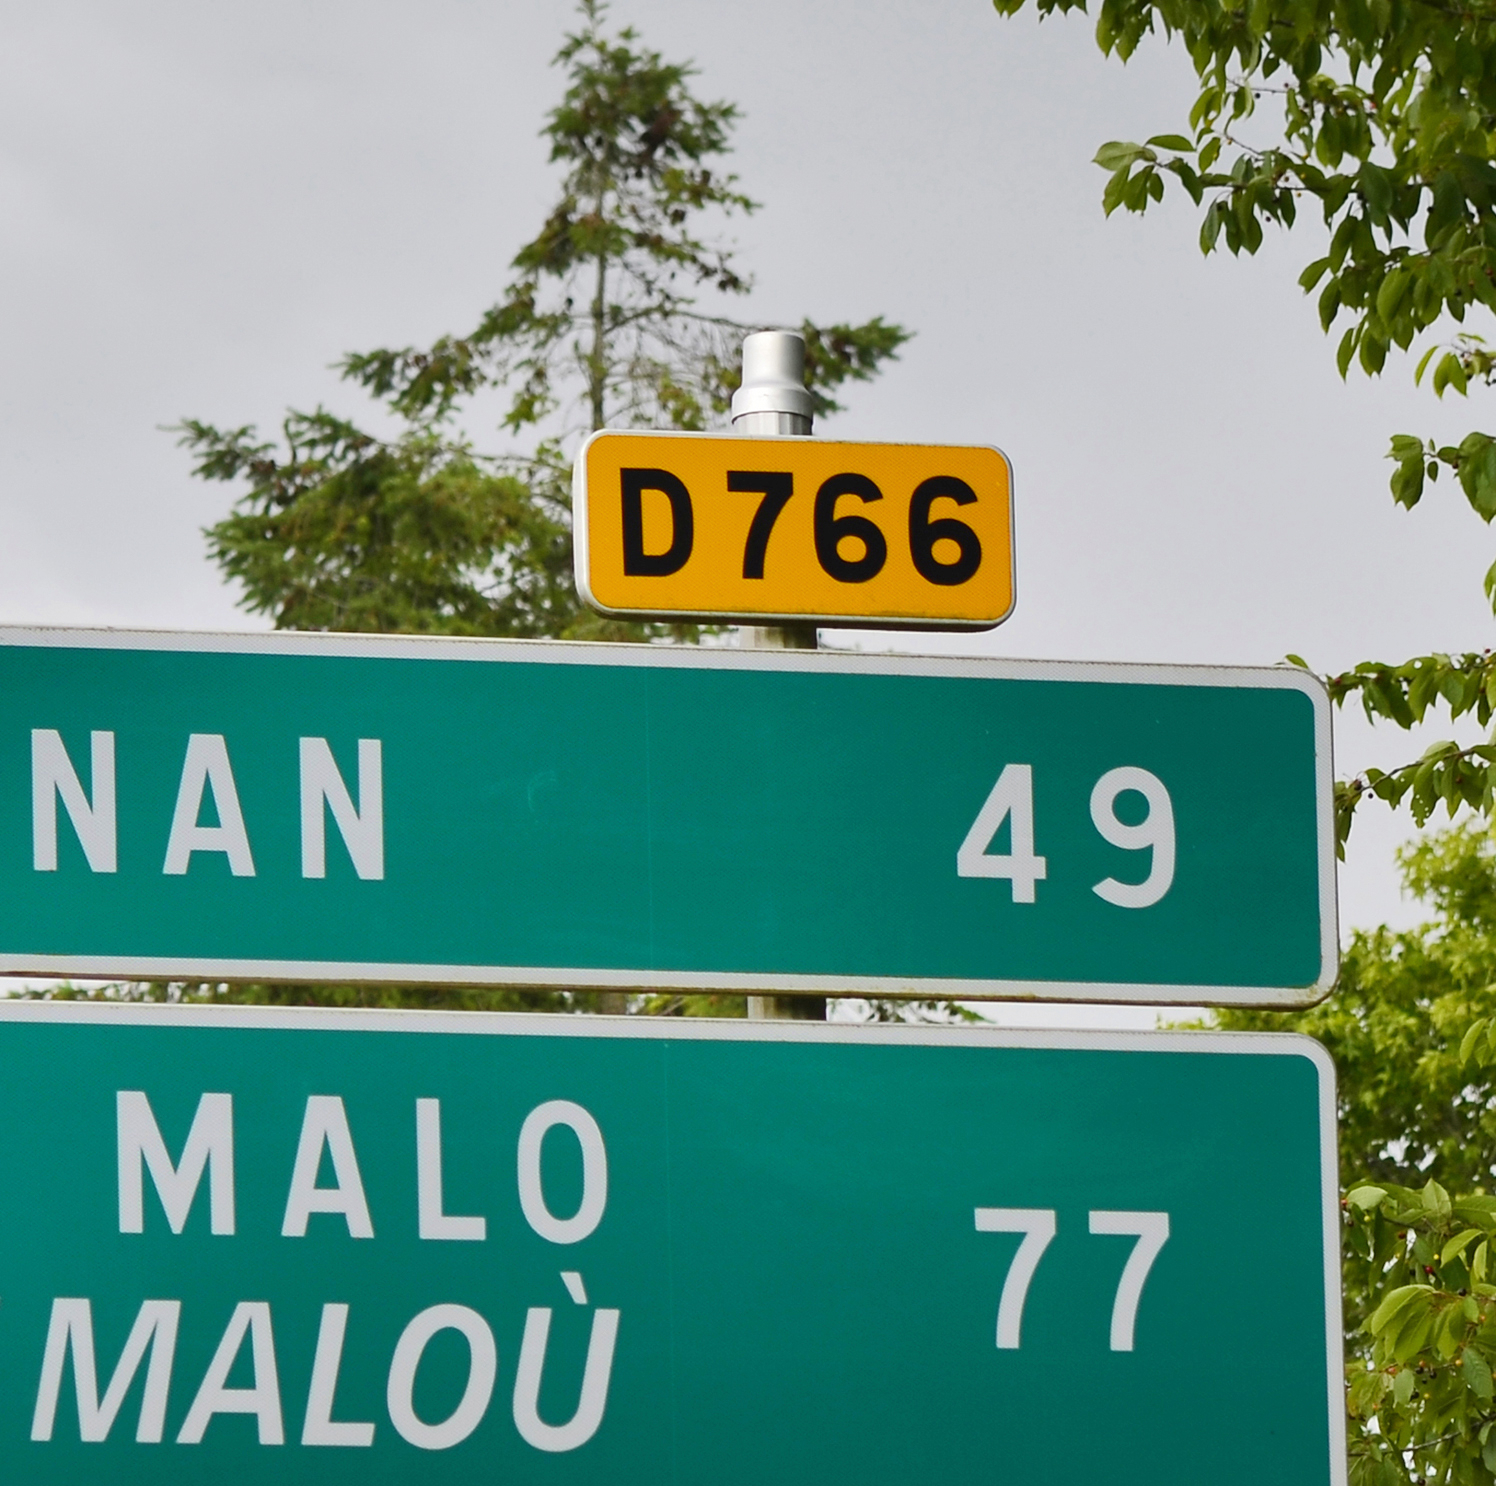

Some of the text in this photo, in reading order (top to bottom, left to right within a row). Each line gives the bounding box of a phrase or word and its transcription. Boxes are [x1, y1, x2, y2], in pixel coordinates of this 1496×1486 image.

[957, 764, 1175, 908] 49
[117, 1091, 607, 1244] MALO
[975, 1208, 1169, 1351] 77
[31, 1272, 620, 1452] MALOÙ
